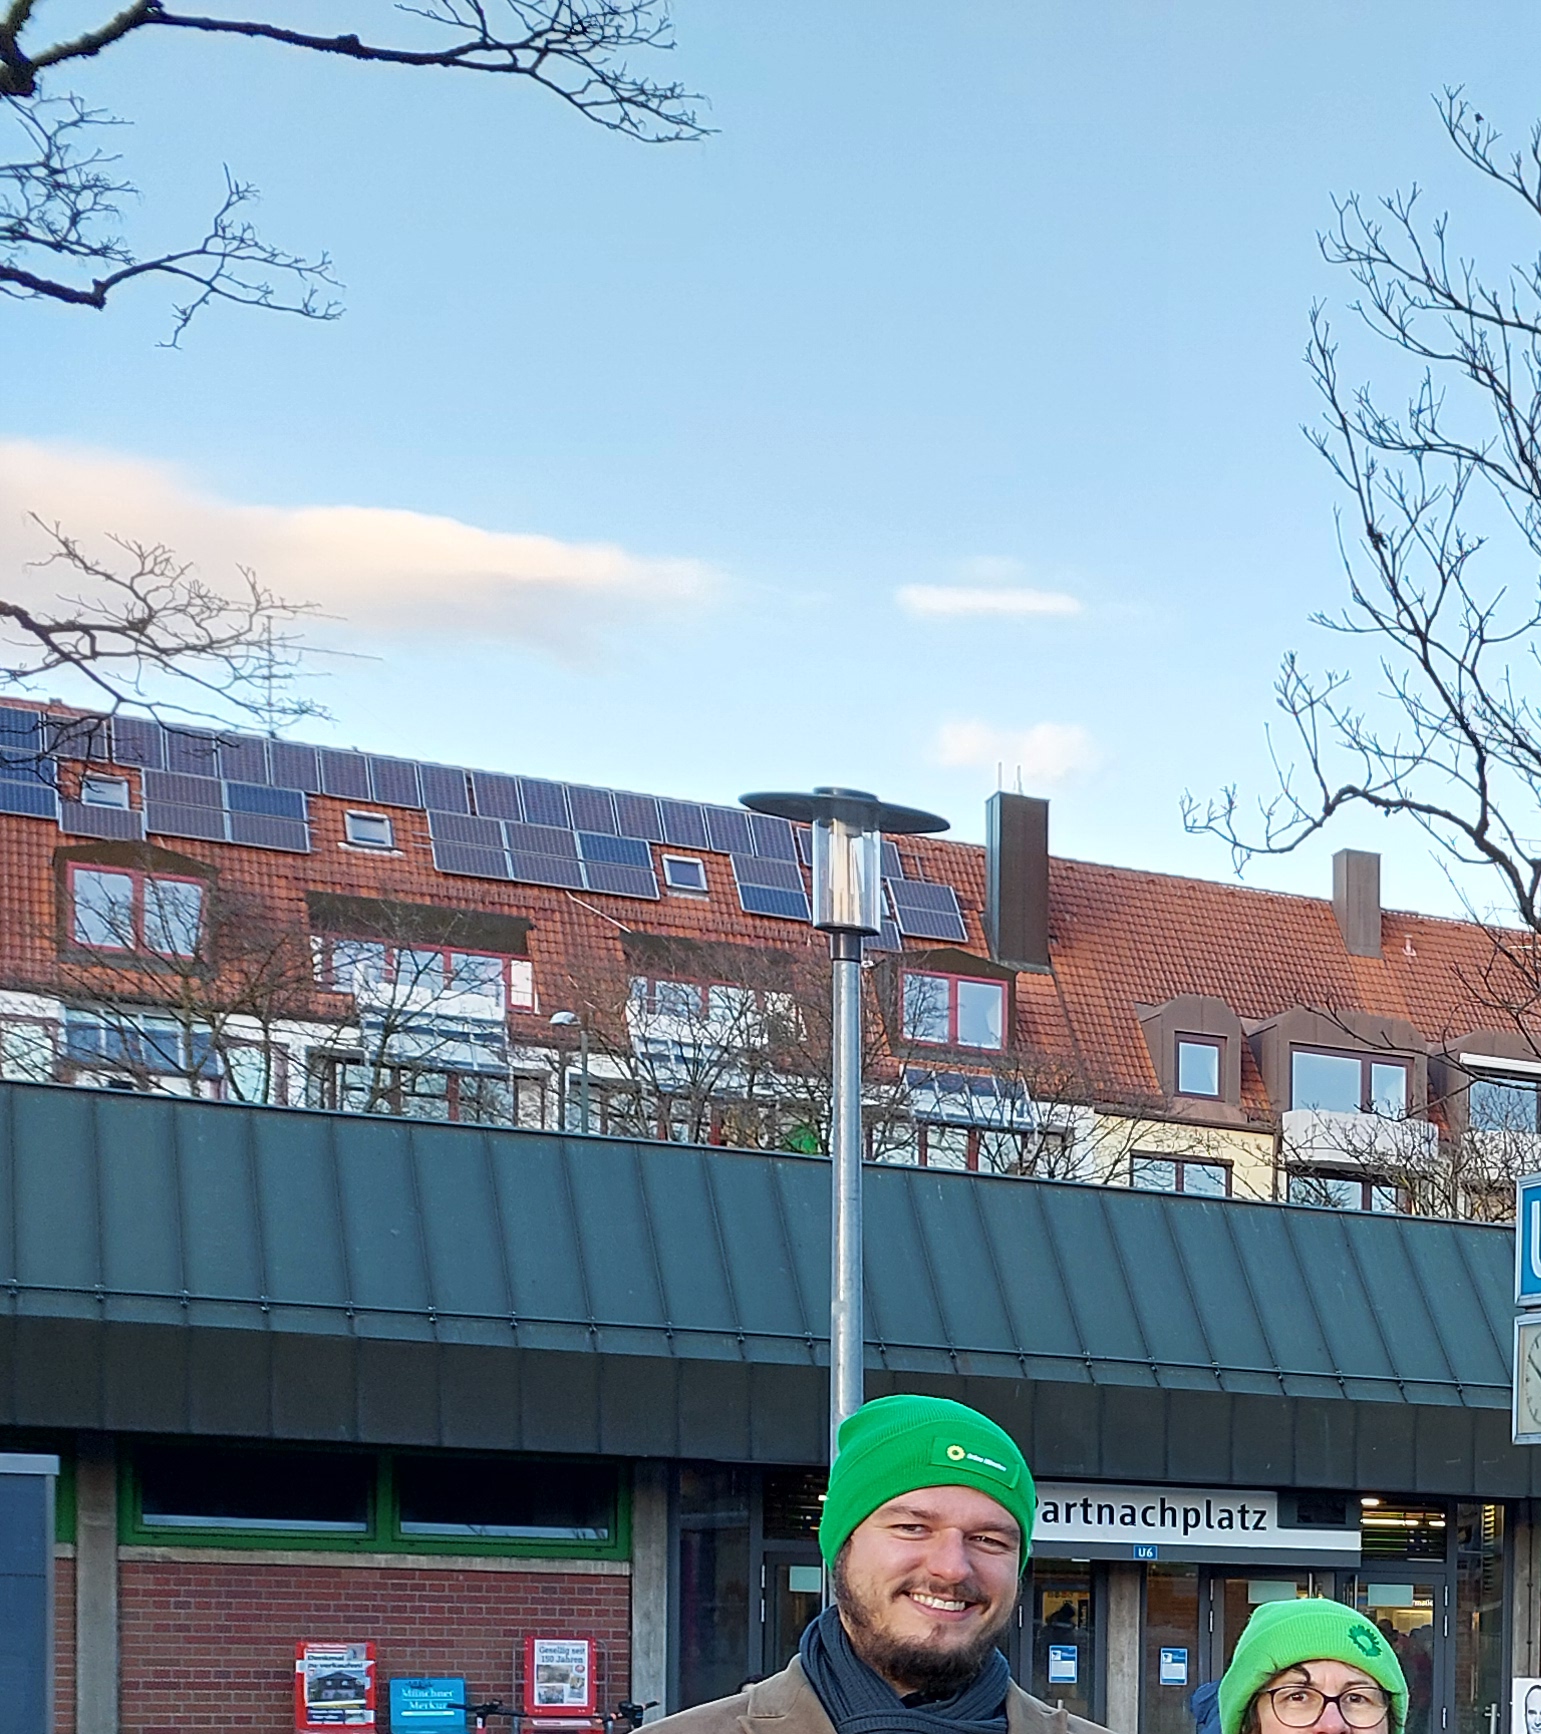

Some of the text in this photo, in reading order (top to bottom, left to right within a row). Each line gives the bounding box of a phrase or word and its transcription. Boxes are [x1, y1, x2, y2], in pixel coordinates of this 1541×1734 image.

[1034, 1497, 1268, 1536] artnachplatz
[1137, 1547, 1154, 1559] U6
[555, 1655, 584, 1664] Jahren
[400, 1687, 454, 1698] Münchner
